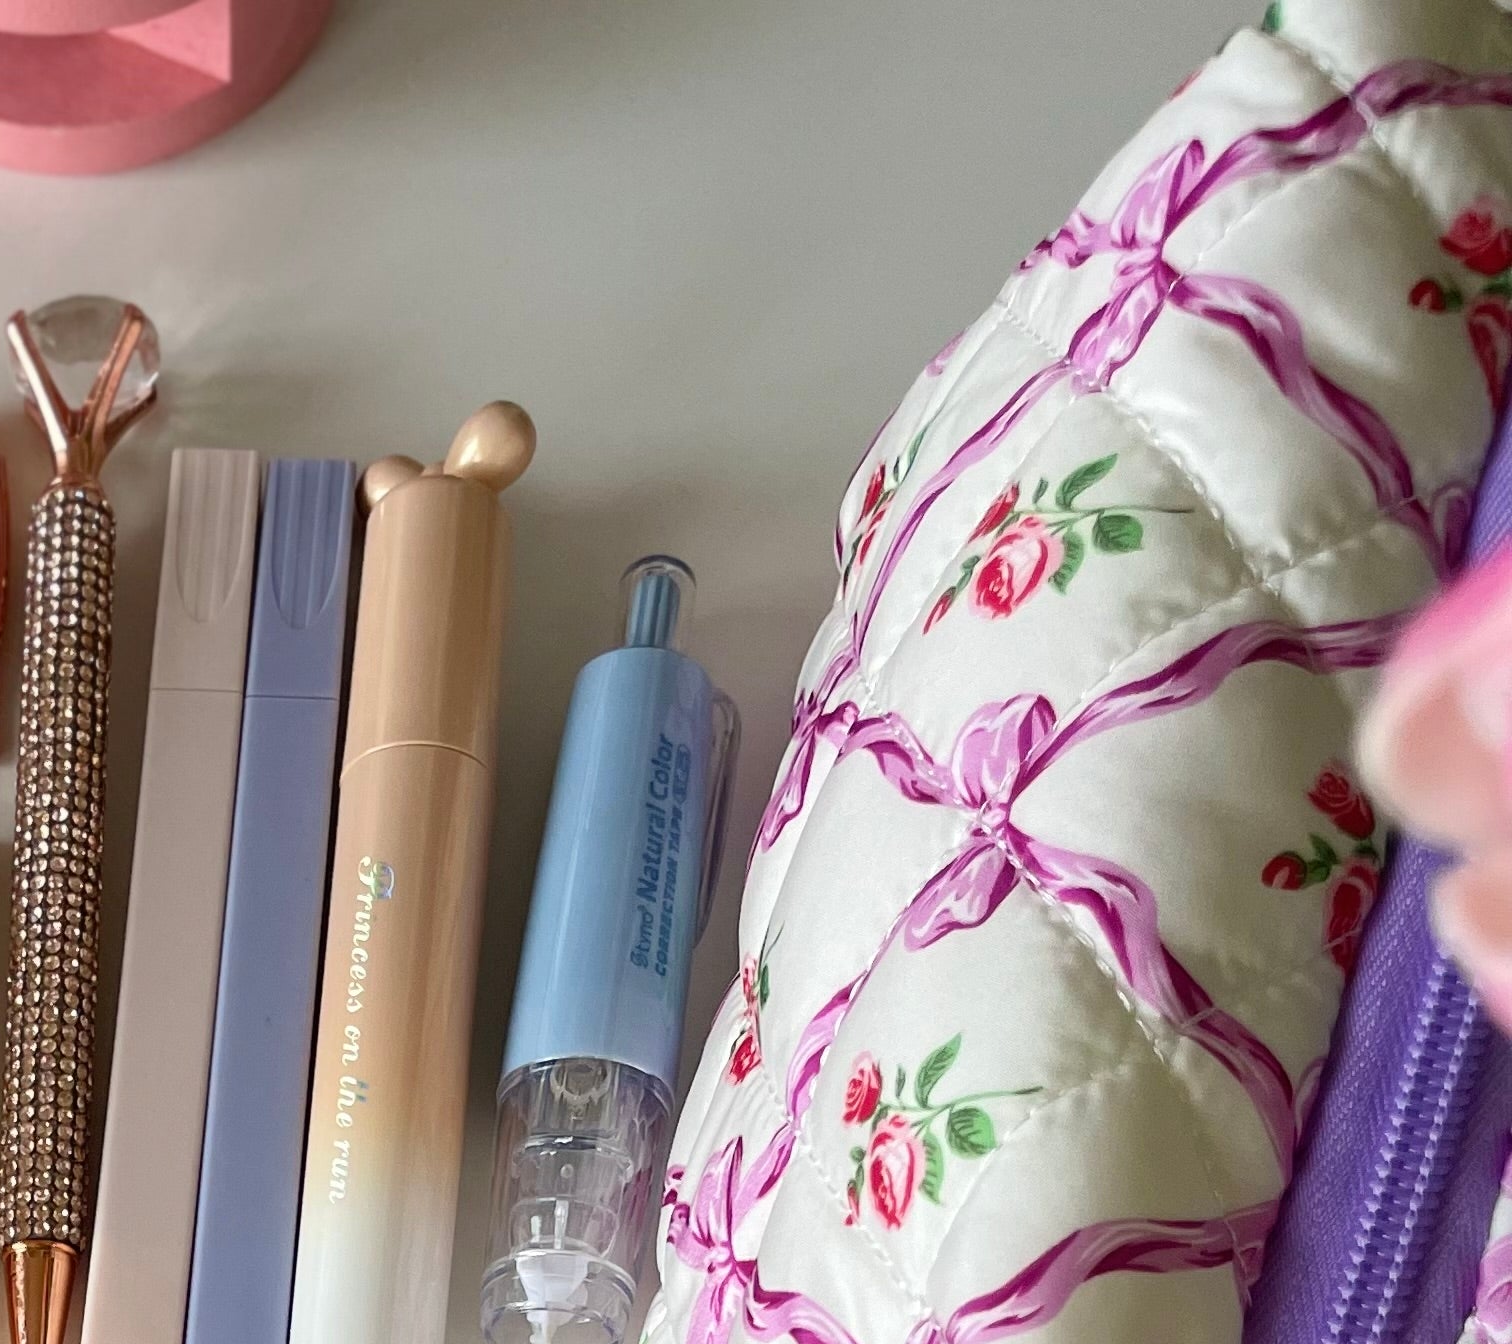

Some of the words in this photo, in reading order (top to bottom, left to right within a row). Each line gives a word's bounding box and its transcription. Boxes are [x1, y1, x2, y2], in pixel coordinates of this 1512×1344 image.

[648, 733, 674, 801] Color
[637, 802, 667, 903] Natural
[341, 1025, 361, 1066] on
[328, 1139, 352, 1204] run
